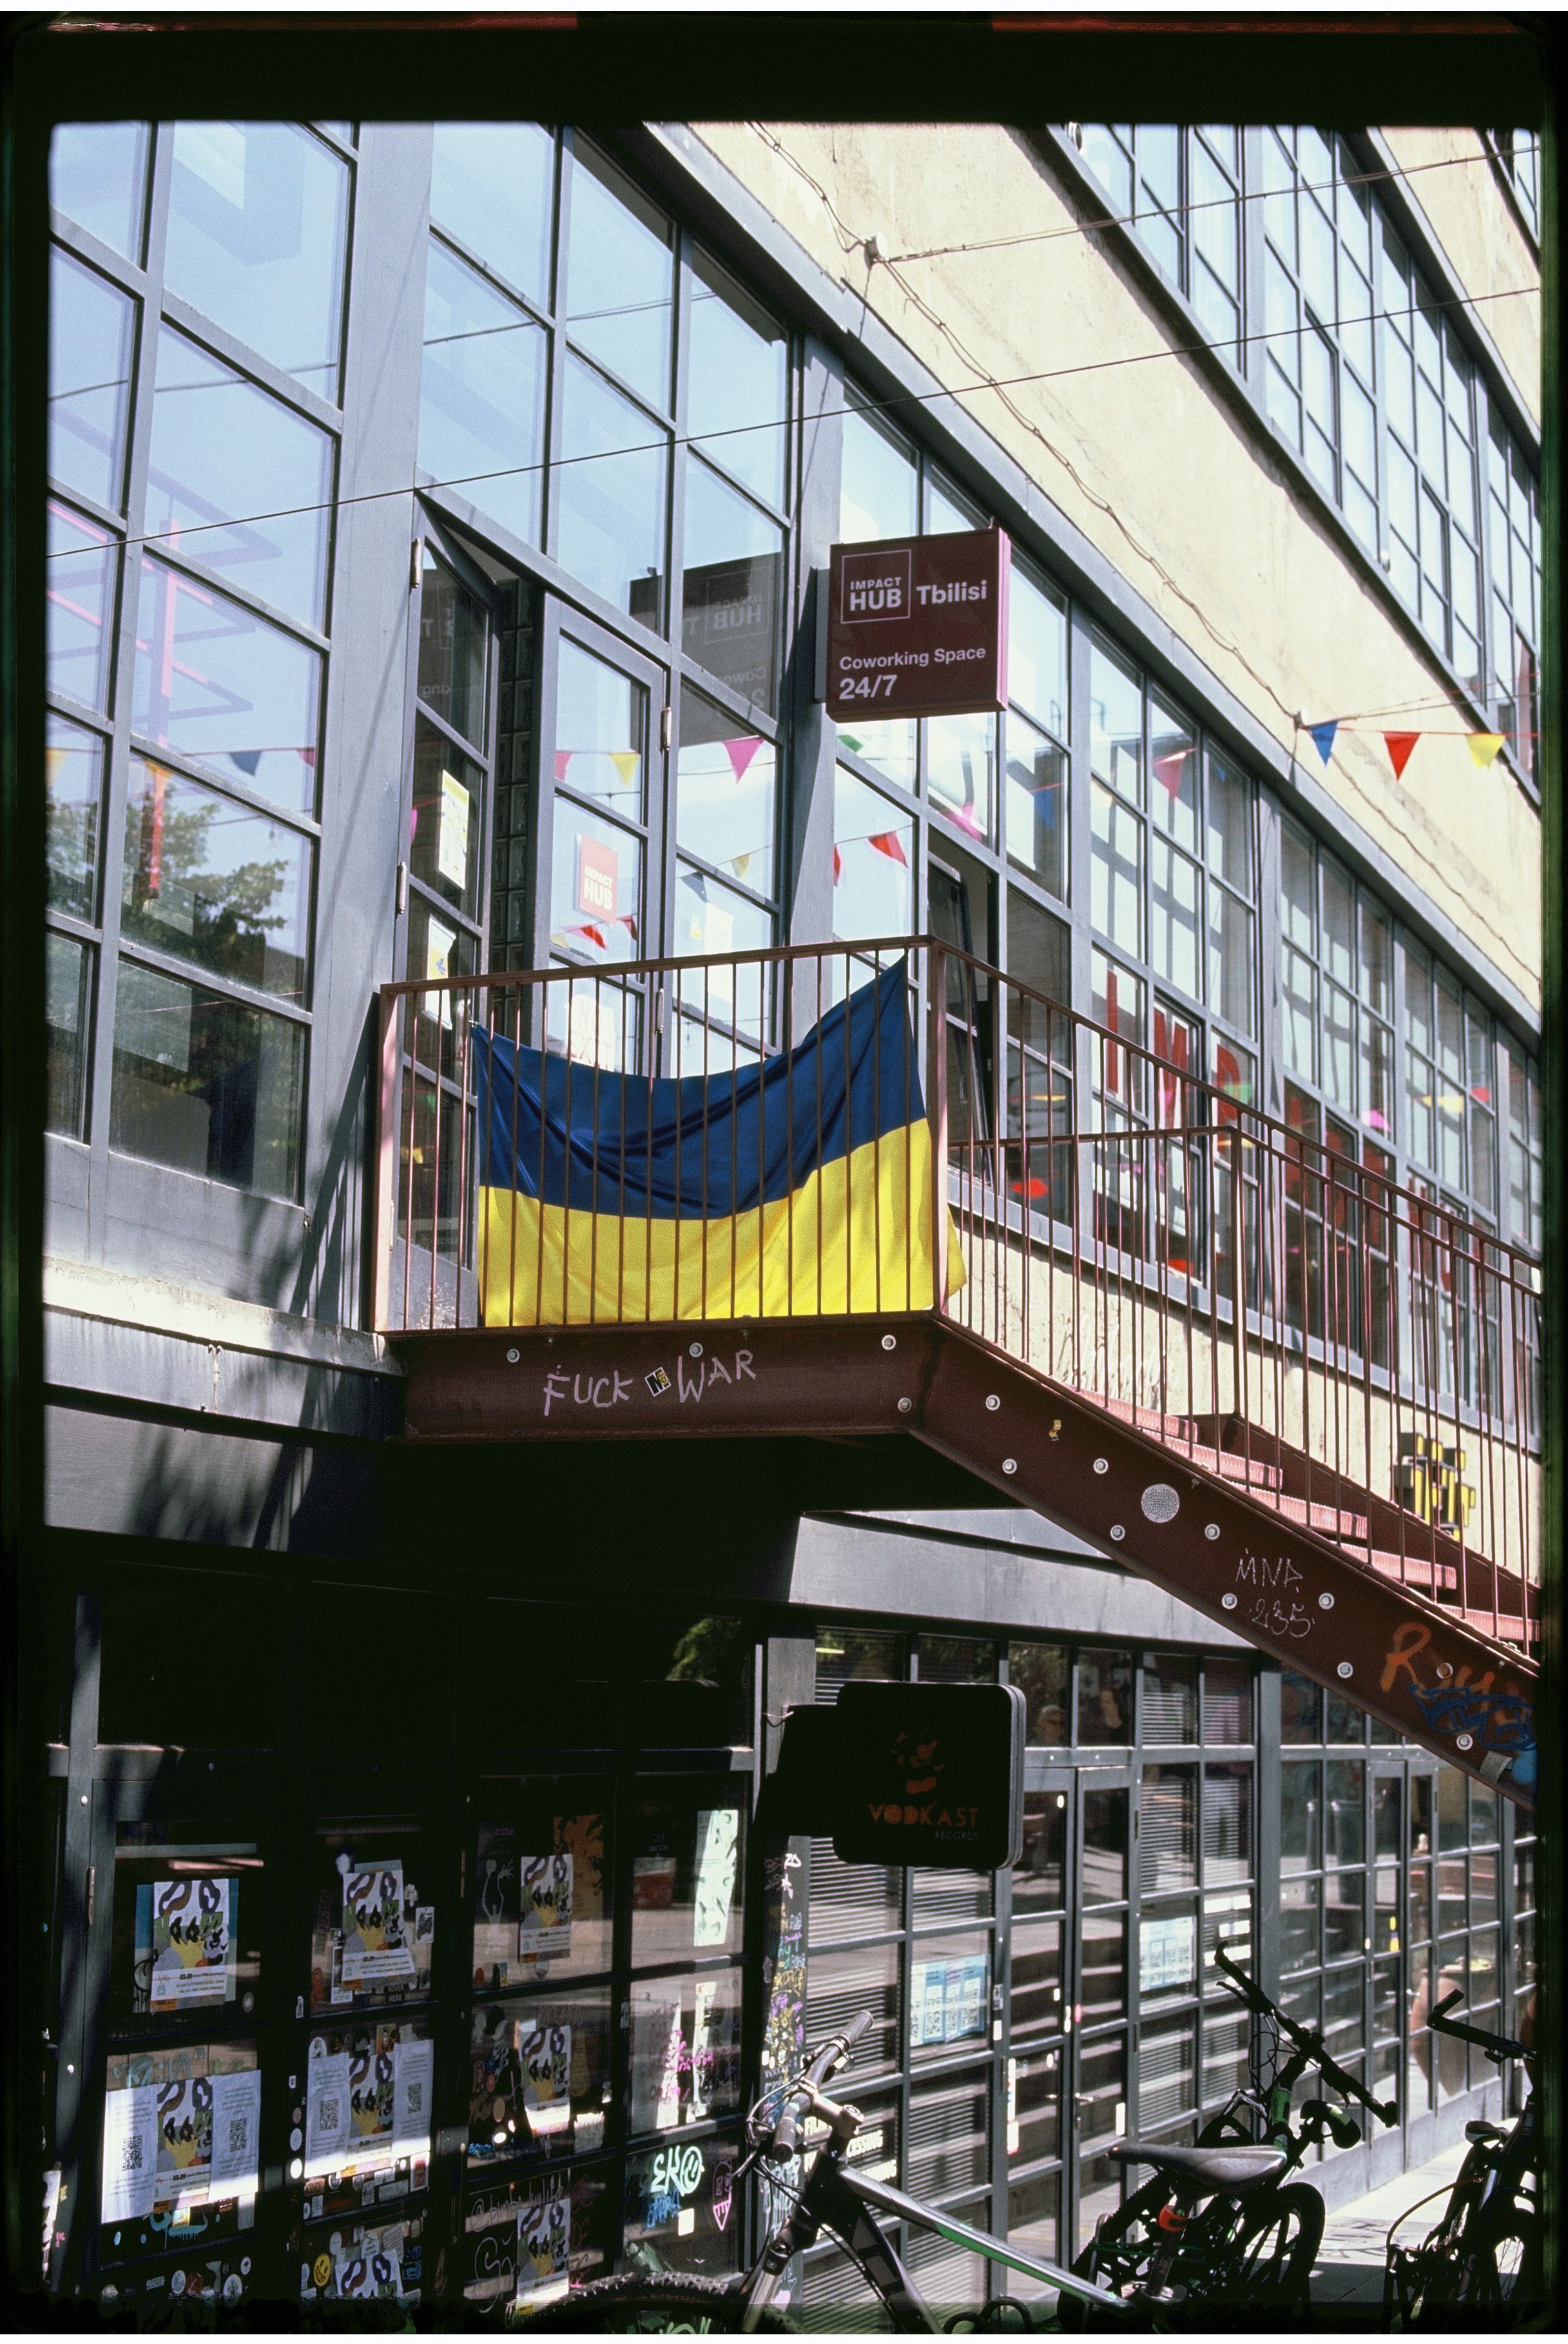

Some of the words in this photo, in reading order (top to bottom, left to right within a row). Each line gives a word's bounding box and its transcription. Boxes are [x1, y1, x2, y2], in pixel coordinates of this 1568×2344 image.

[850, 577, 902, 590] IMPACT
[916, 580, 987, 605] Tbilisi
[849, 588, 902, 611] HUB
[839, 652, 929, 670] Coworking
[934, 648, 986, 664] Space
[838, 674, 898, 700] 24/7
[583, 877, 613, 911] HUB
[543, 1366, 634, 1417] FUCK
[678, 1350, 757, 1403] WAR
[868, 1800, 979, 1828] VODKAST
[934, 1831, 979, 1841] RECORDS
